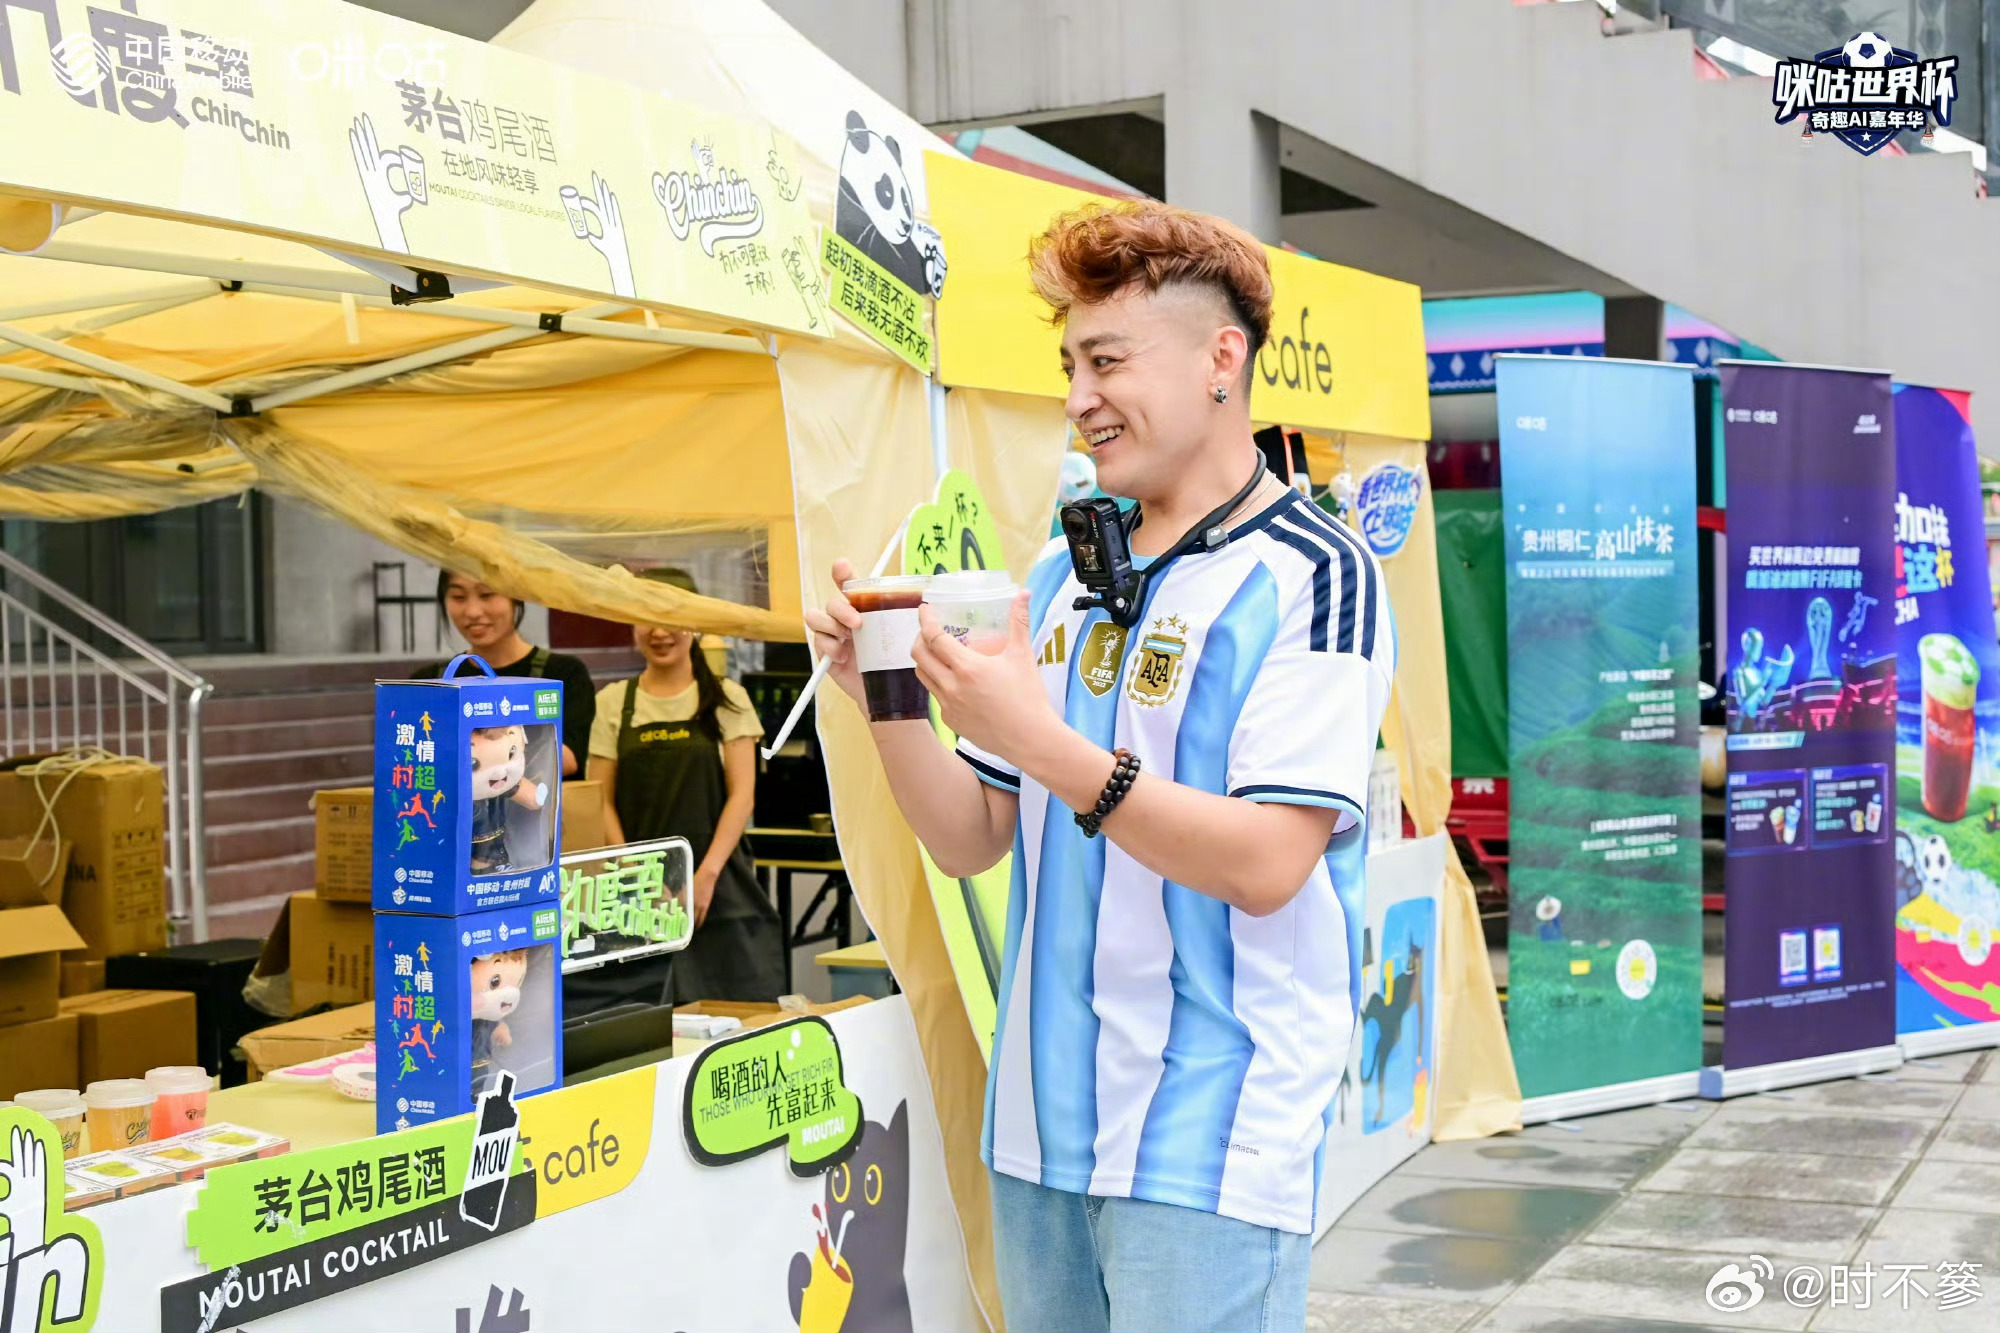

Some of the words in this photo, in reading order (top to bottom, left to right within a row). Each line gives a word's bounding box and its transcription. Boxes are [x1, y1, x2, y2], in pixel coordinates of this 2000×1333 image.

[396, 78, 558, 166] 茅台鸡尾酒
[428, 181, 458, 199] MOUTAI
[440, 147, 541, 195] 在地风味轻享
[824, 238, 917, 324] 起初我滴酒不沾
[840, 280, 929, 365] 后来我无酒不欢
[1260, 306, 1333, 395] cafe
[1090, 667, 1115, 680] FIFA
[392, 763, 436, 791] 村超
[393, 994, 436, 1021] 村超
[699, 1099, 731, 1124] THOSE
[784, 1070, 801, 1091] GET
[801, 1062, 821, 1083] RICH
[710, 1050, 788, 1101] 喝酒的人
[766, 1076, 836, 1130] 先富起来
[471, 1136, 511, 1180] MOU
[543, 1117, 620, 1185] cafe
[801, 1115, 846, 1147] MOUTAI
[253, 1144, 447, 1234] 茅台鸡尾酒
[322, 1217, 450, 1278] COCKTAIL
